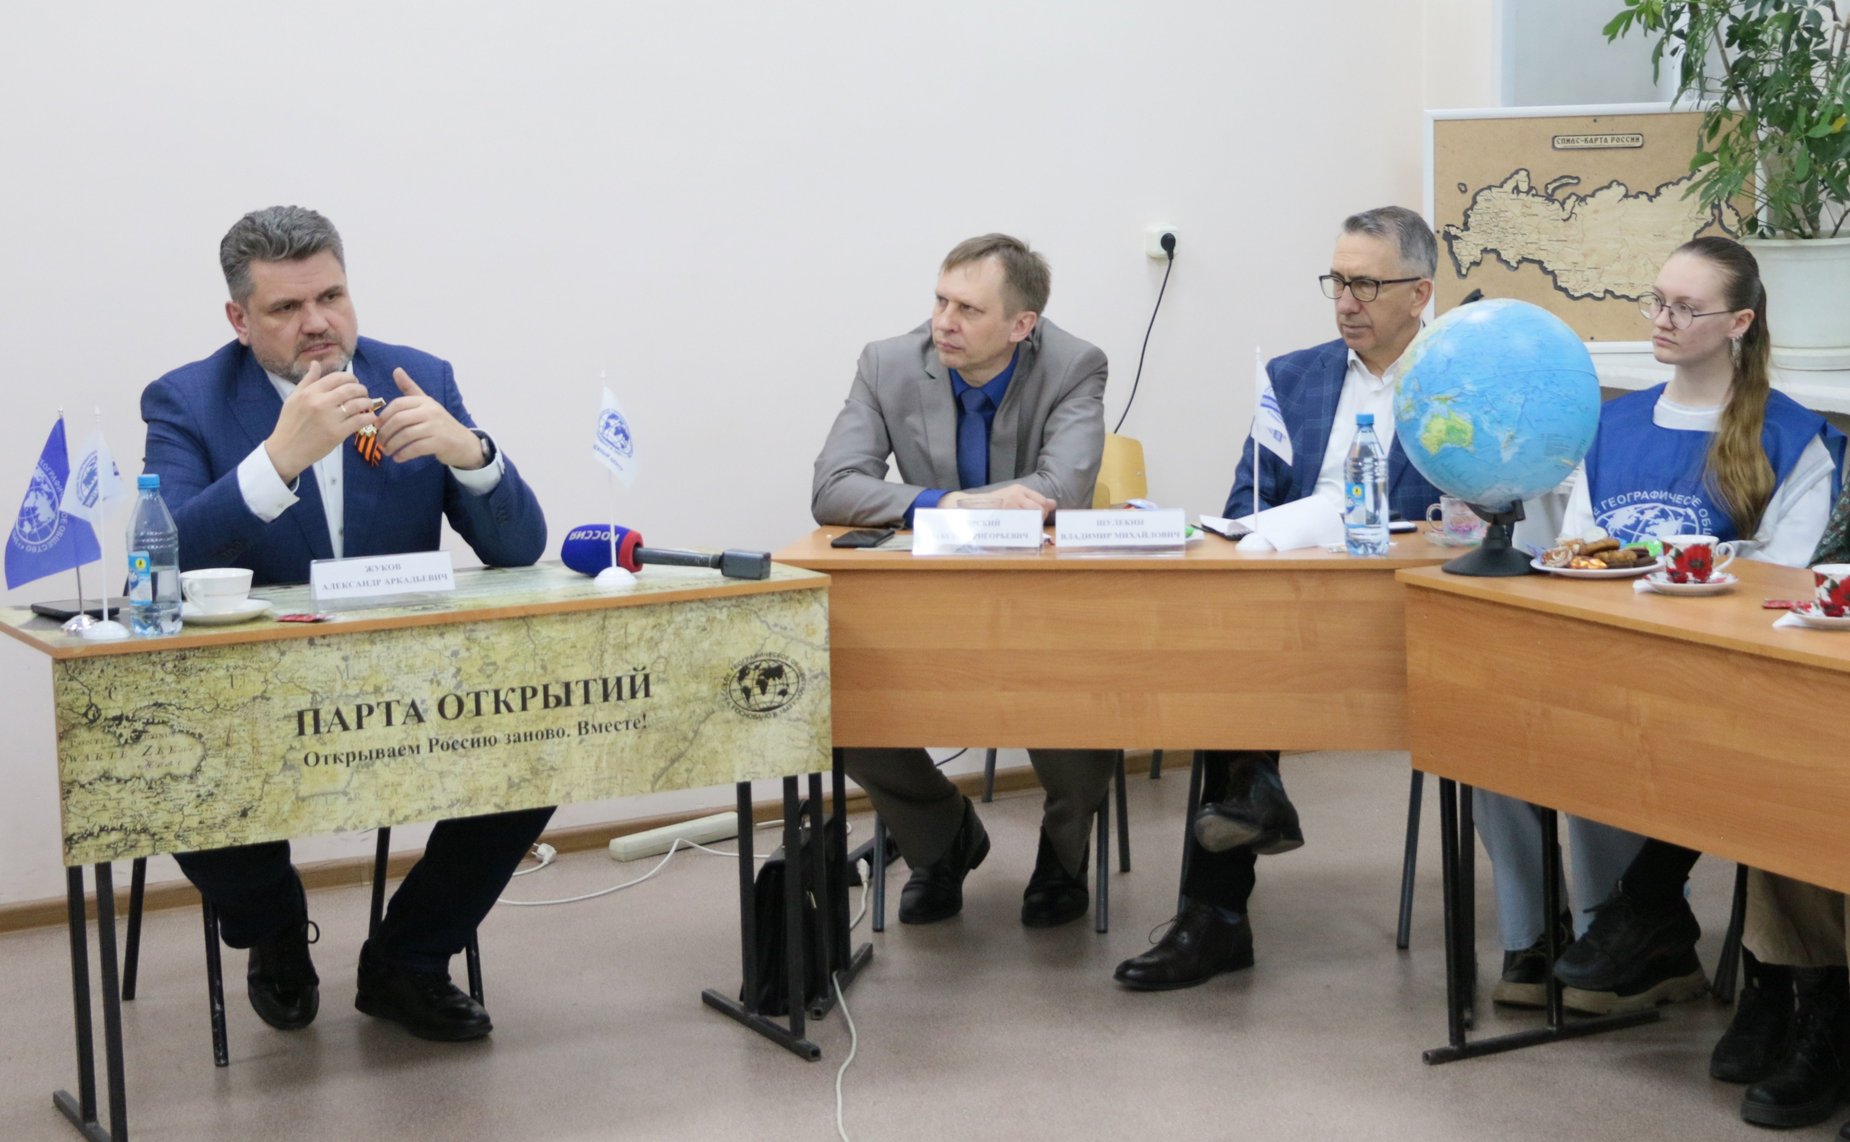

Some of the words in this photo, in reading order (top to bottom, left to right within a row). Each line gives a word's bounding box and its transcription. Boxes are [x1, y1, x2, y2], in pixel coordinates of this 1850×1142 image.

[1610, 135, 1640, 144] РОССИИ
[1060, 532, 1111, 541] ВЛАДИМИР
[1115, 530, 1181, 540] МИХАЙЛОВИЧ
[365, 563, 402, 573] ЖУКОВ
[322, 578, 382, 591] АЛЕКСАНДР
[385, 573, 448, 586] АРКАДЬЕВИЧ
[296, 698, 426, 737] ПАРТА
[437, 666, 653, 721] ОТКРЫТИЙ
[303, 741, 422, 768] Открываем
[427, 733, 498, 754] Россию
[504, 726, 571, 745] заново.
[577, 713, 648, 738] Вместе!
